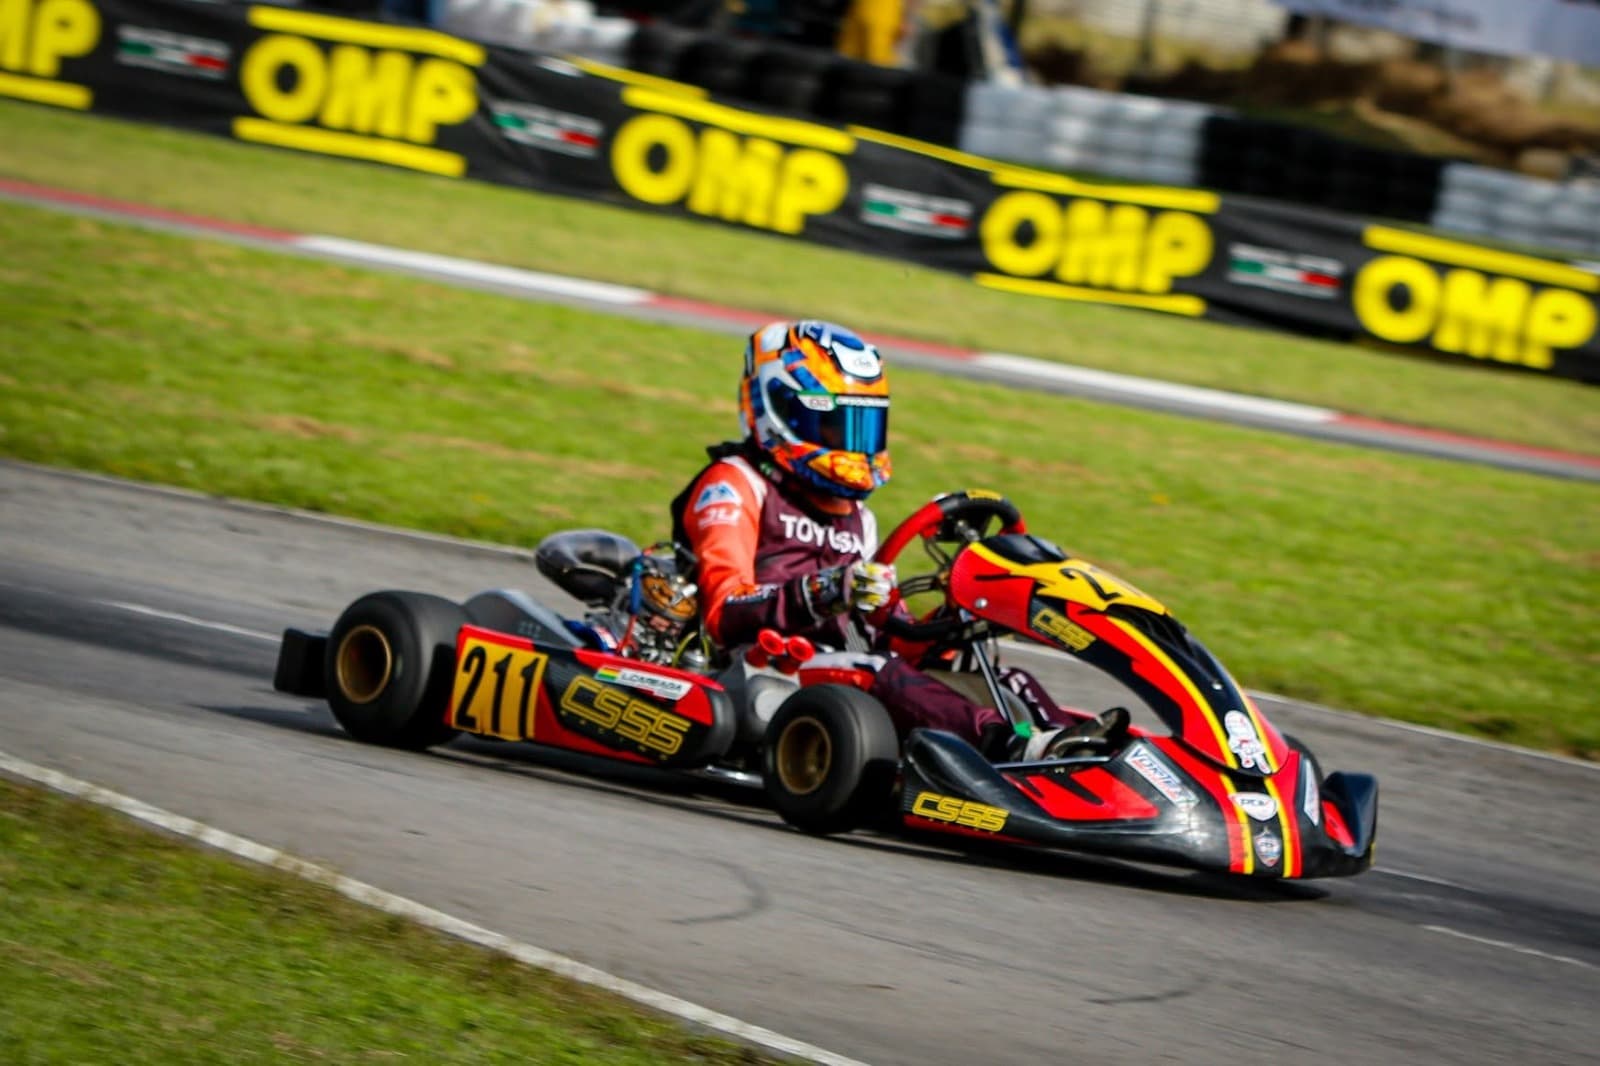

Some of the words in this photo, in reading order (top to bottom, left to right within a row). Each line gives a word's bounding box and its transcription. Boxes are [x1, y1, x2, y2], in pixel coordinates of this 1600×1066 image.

[241, 34, 479, 144] OMP
[610, 112, 848, 234] OMP
[980, 190, 1214, 293] OMP
[1353, 255, 1597, 370] OMP
[455, 646, 541, 739] 211
